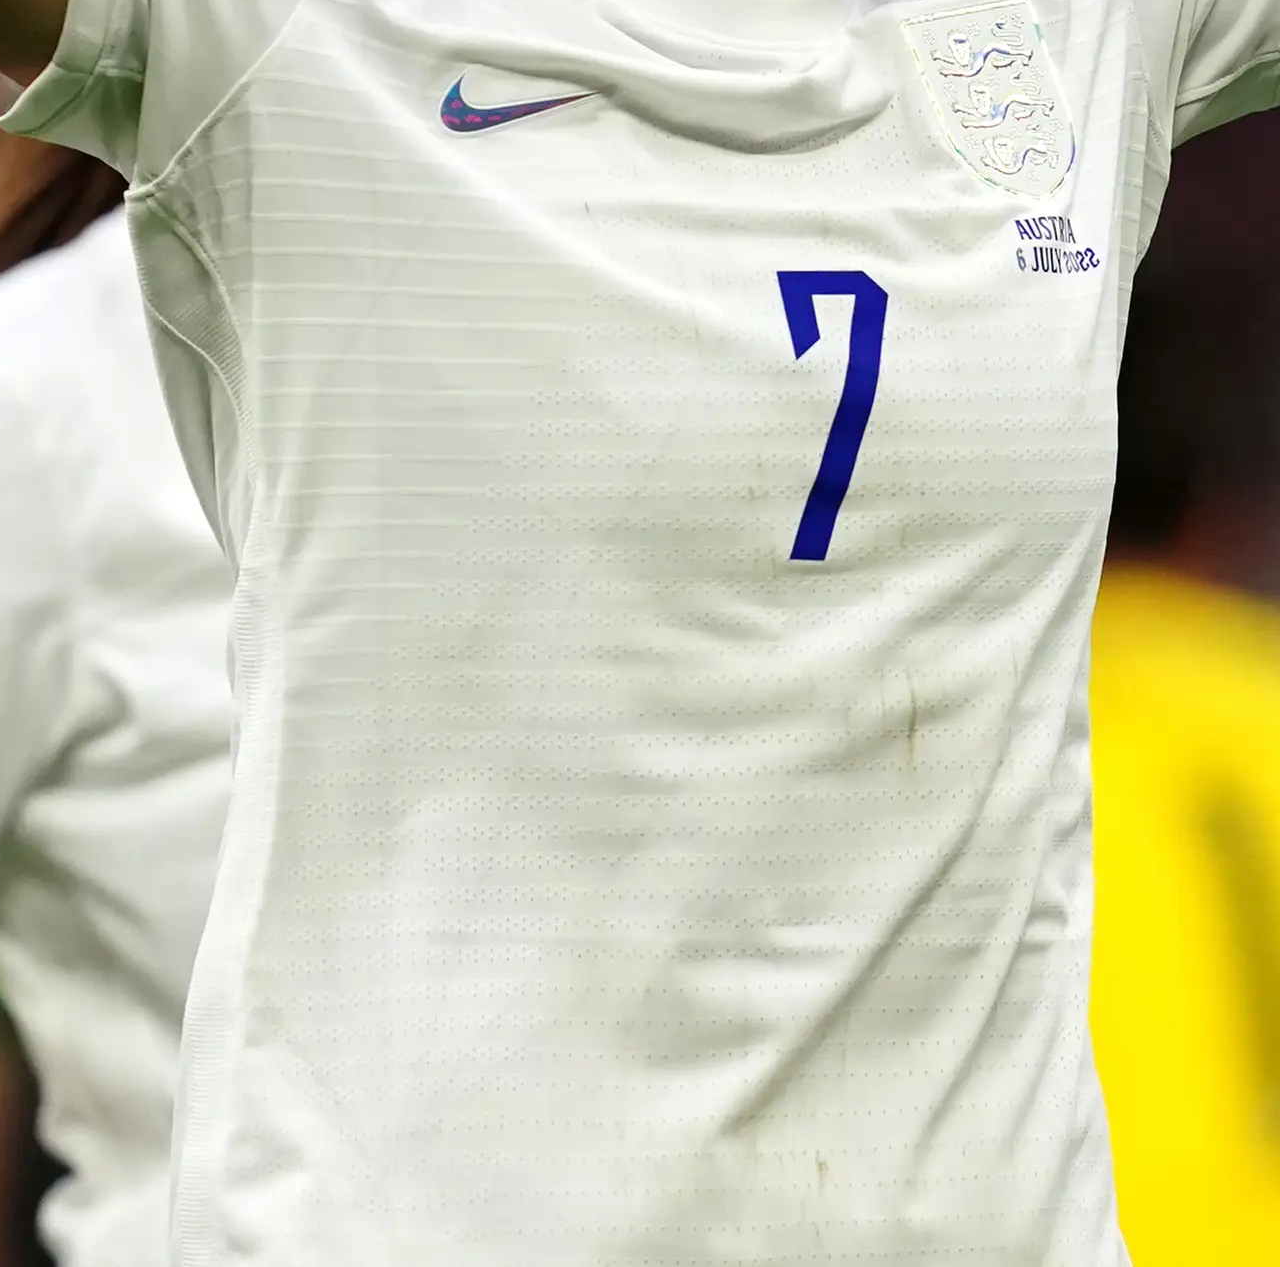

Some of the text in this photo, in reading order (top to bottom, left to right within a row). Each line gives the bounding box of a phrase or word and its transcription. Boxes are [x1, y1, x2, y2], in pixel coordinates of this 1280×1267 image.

[1015, 216, 1076, 244] AUSTRIA
[1016, 247, 1027, 271] 6
[1031, 246, 1062, 274] JULY
[776, 270, 889, 562] 7
